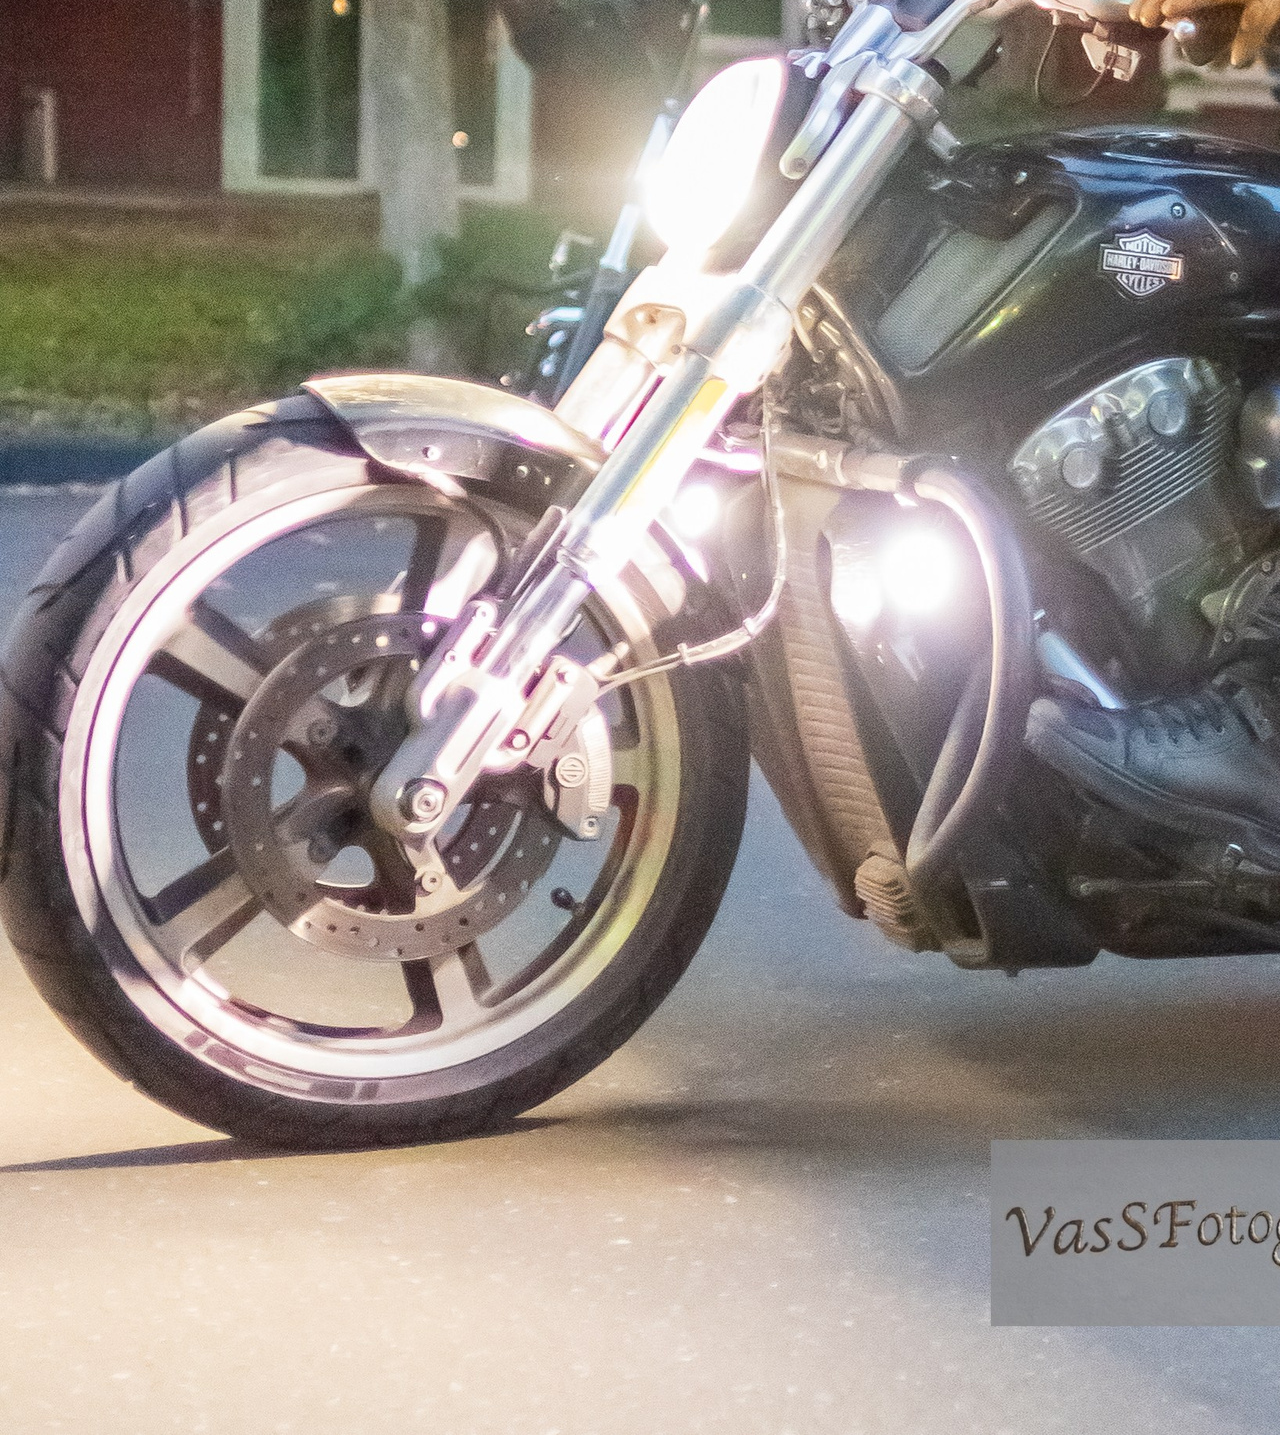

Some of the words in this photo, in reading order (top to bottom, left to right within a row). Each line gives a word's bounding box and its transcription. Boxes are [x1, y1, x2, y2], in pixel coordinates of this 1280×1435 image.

[1125, 238, 1165, 255] MOTOR
[1106, 253, 1178, 275] HARLEY-DAVIDSON
[1121, 273, 1160, 292] CYCLES
